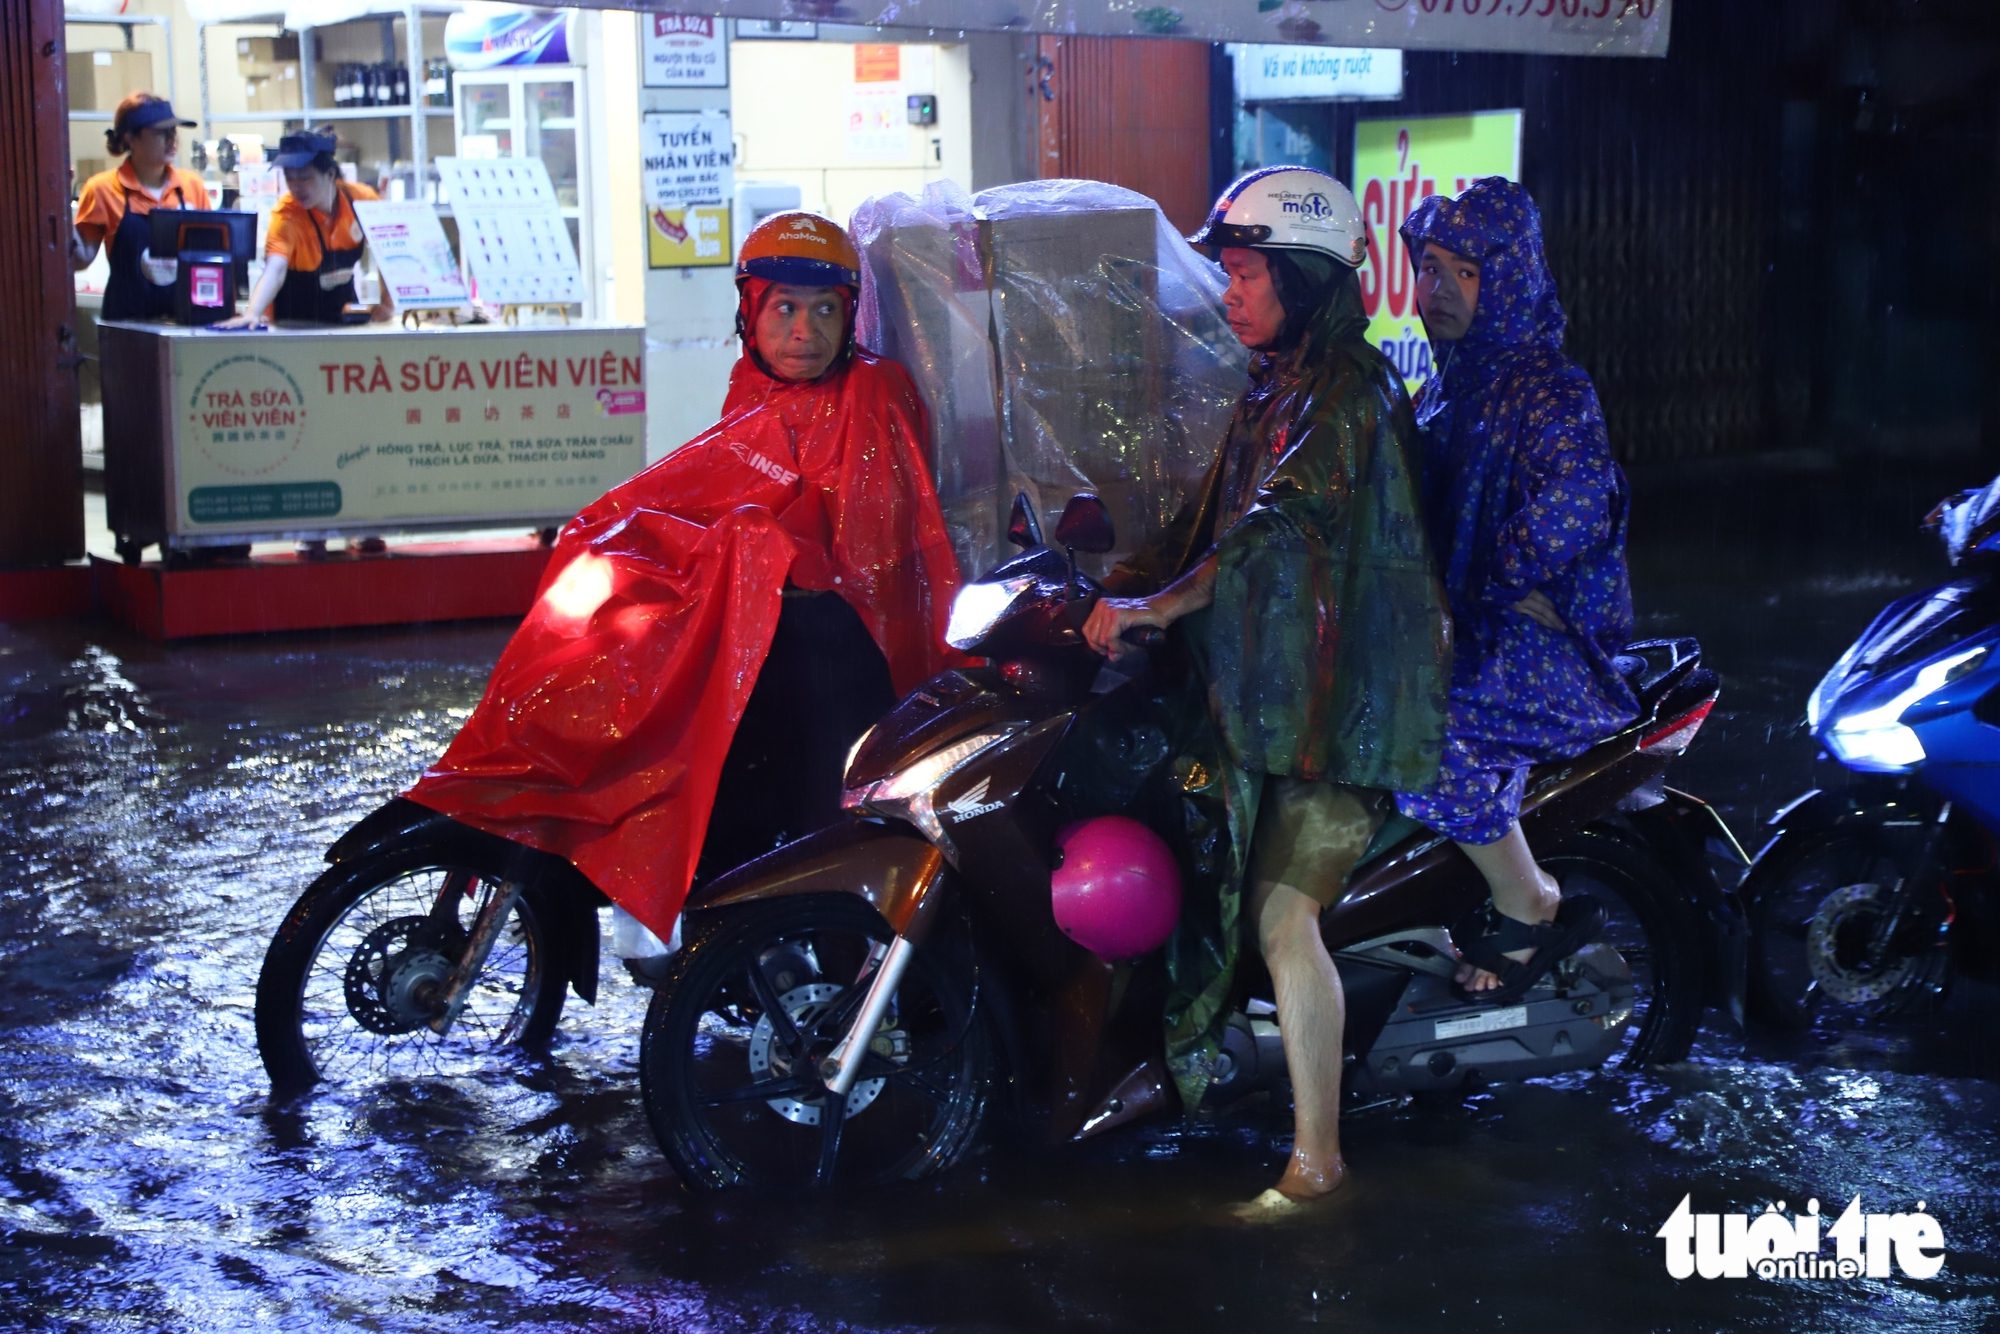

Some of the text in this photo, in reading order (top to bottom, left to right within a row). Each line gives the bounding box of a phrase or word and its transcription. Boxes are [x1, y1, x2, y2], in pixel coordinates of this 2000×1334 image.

[1344, 48, 1372, 79] ruột
[658, 124, 713, 147] TUYỂN
[645, 152, 731, 170] NHÂN VIÊN
[1267, 193, 1303, 202] HELMET
[1283, 196, 1333, 217] moto
[778, 232, 827, 245] AhaMove
[319, 356, 392, 395] TRÀ
[399, 355, 475, 391] SỮA
[479, 351, 557, 389] VIÊN
[566, 349, 642, 386] VIÊN
[206, 388, 291, 408] TRÀ SỮA
[202, 408, 295, 428] VIÊN VIÊN
[952, 801, 1005, 823] HONDA
